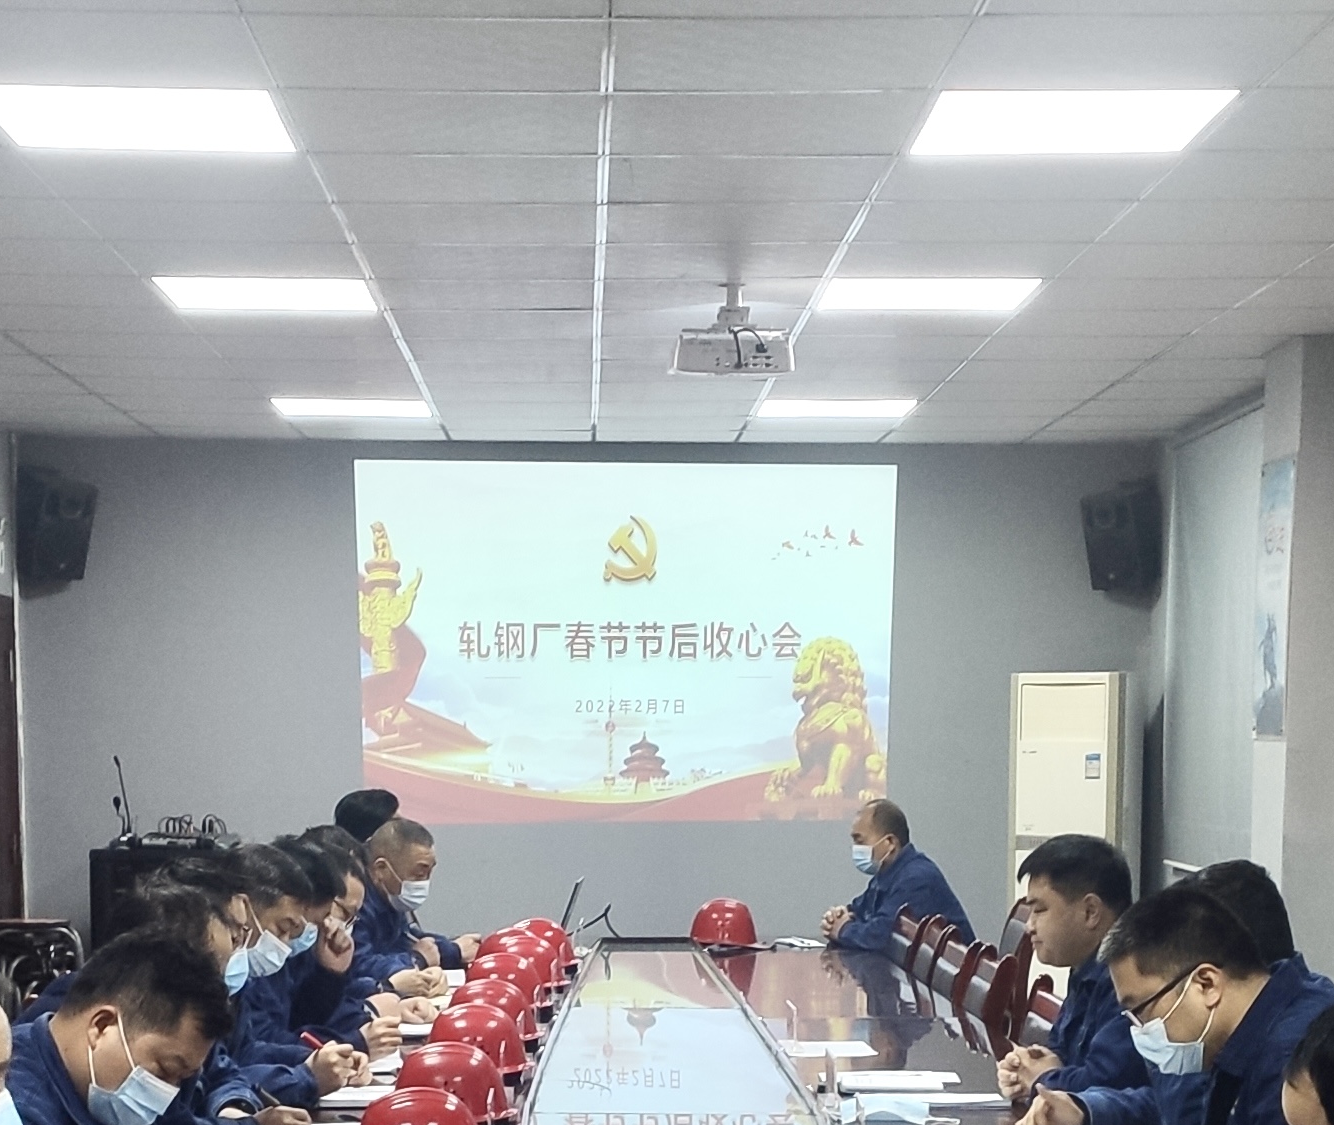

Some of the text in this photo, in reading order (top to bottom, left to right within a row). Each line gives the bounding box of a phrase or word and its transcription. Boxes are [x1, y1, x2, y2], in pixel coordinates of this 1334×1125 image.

[457, 620, 803, 661] 轧钢厂春节节后收心会
[575, 699, 686, 715] 2022年2月7日
